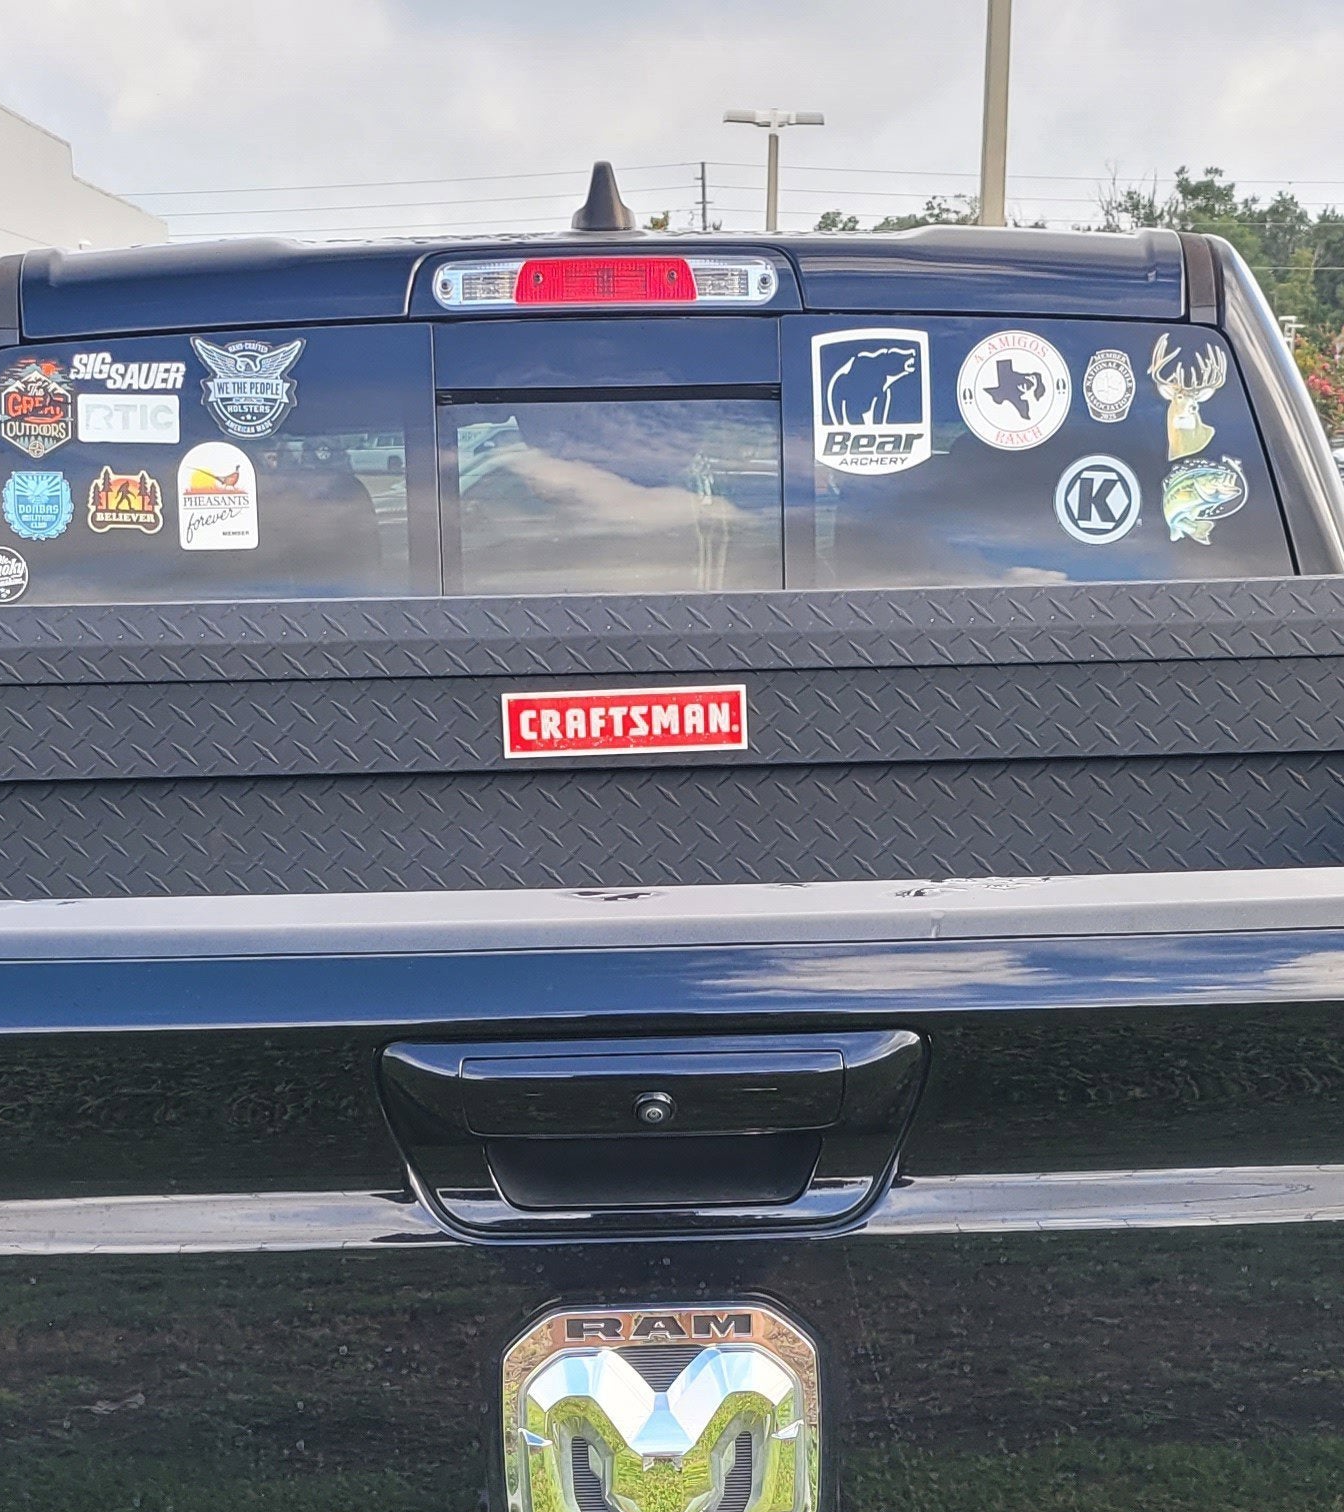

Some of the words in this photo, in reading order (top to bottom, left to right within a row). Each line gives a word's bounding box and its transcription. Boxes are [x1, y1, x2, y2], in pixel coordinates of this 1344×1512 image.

[987, 335, 1049, 358] AMIGOS
[1093, 353, 1127, 362] MEMBER
[69, 351, 112, 380] SIG
[106, 361, 186, 390] SAUER
[1086, 362, 1118, 387] NATIONAL
[1118, 365, 1133, 388] RIFLE
[26, 381, 45, 397] The
[216, 381, 230, 395] WE
[232, 381, 247, 395] THE
[249, 381, 280, 396] PEOPLE
[227, 405, 271, 413] HOLSTERS
[1087, 391, 1132, 411] ASSOCIATION
[85, 403, 175, 431] RTIC
[225, 420, 255, 433] AMERICAN
[256, 420, 273, 433] MADE
[6, 421, 67, 440] OUTDOORS
[994, 426, 1043, 445] RANCH
[822, 431, 924, 456] Bear
[839, 457, 909, 466] ARCHERY
[183, 495, 250, 507] PHEASANTS
[1077, 477, 1119, 523] K
[96, 512, 156, 523] BELIEVER
[186, 507, 242, 544] forever
[518, 701, 731, 741] CRAFTSMAN
[564, 1312, 754, 1343] RAM
